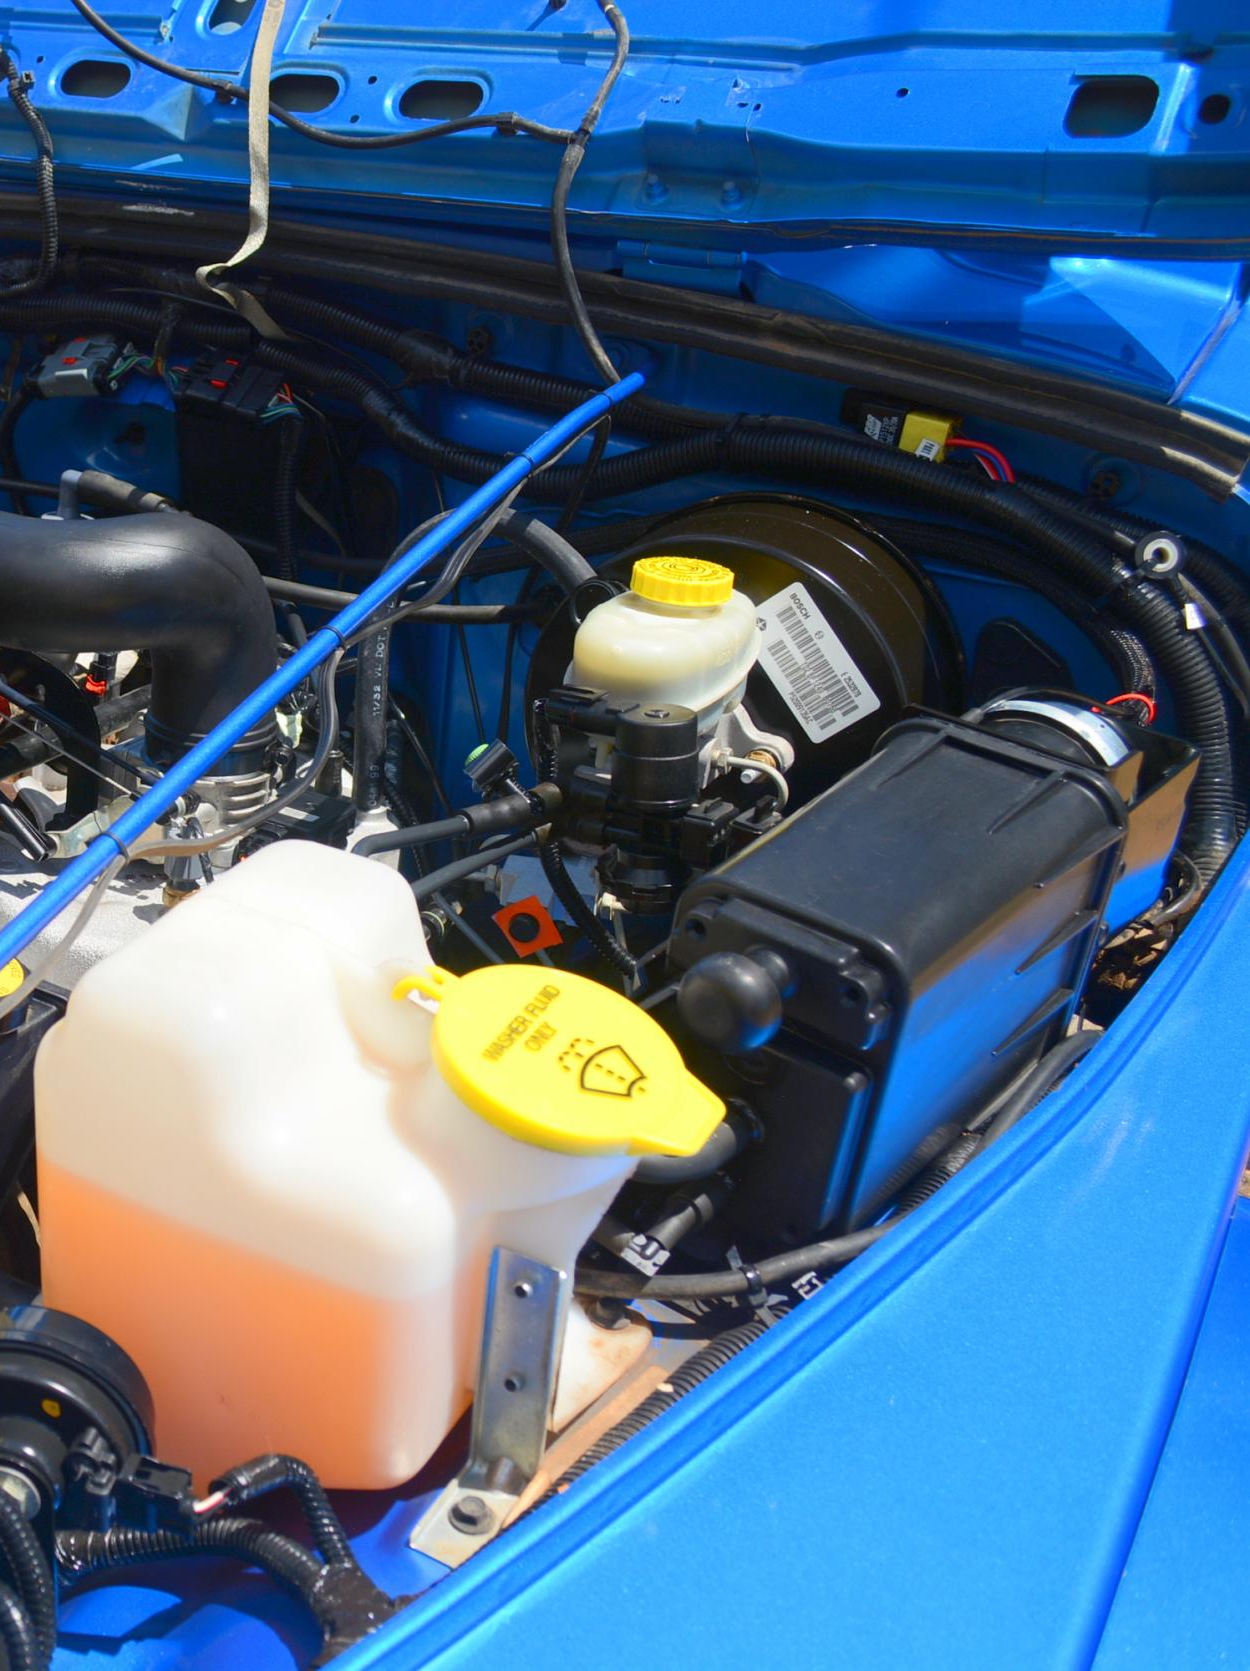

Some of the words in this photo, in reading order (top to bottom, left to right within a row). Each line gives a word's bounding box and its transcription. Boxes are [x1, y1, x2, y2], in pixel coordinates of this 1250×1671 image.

[790, 593, 811, 620] BOSCH
[375, 635, 386, 658] DOT
[482, 1014, 532, 1063] WASHER
[524, 984, 561, 1019] FLUID
[524, 1021, 558, 1052] ONLY
